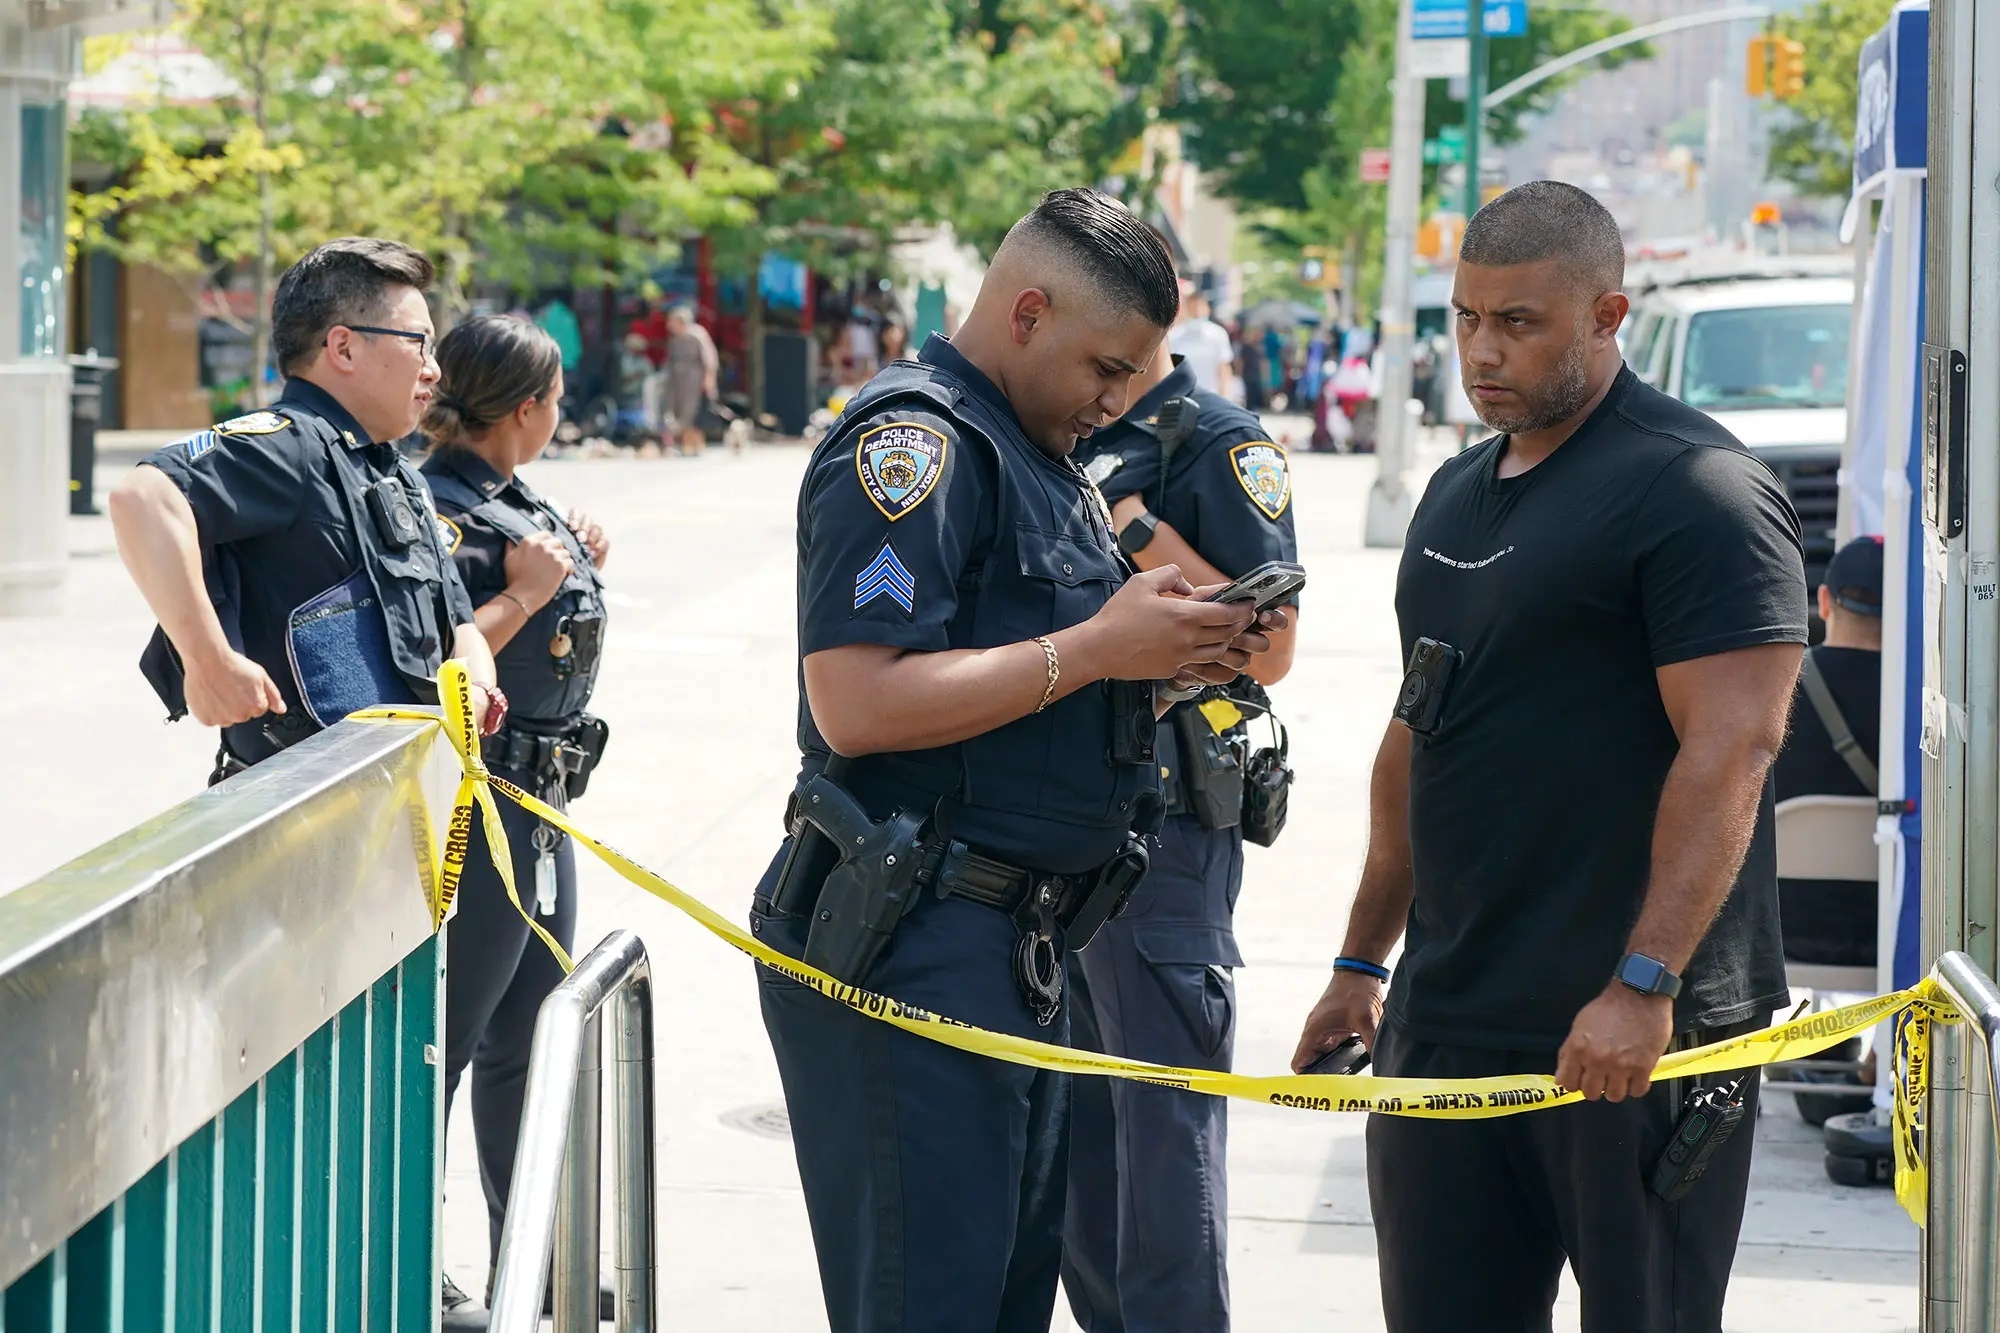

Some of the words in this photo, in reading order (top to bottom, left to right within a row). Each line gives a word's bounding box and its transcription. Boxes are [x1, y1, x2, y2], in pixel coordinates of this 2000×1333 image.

[881, 428, 924, 441] POLICE
[864, 438, 938, 458] DEPARTMENT
[861, 463, 877, 487] CITY
[872, 487, 886, 502] OF
[900, 489, 921, 509] NEW
[918, 463, 939, 492] YORK
[1422, 547, 1436, 557] Your
[1434, 552, 1458, 567] dreams
[1456, 561, 1478, 570] started
[1973, 583, 1997, 594] VAULT
[1977, 591, 1995, 601] D65
[444, 805, 473, 865] CROSS
[1269, 1092, 1331, 1112] CROSS
[1422, 1093, 1483, 1111] SCENE
[1488, 1087, 1546, 1107] CRIME
